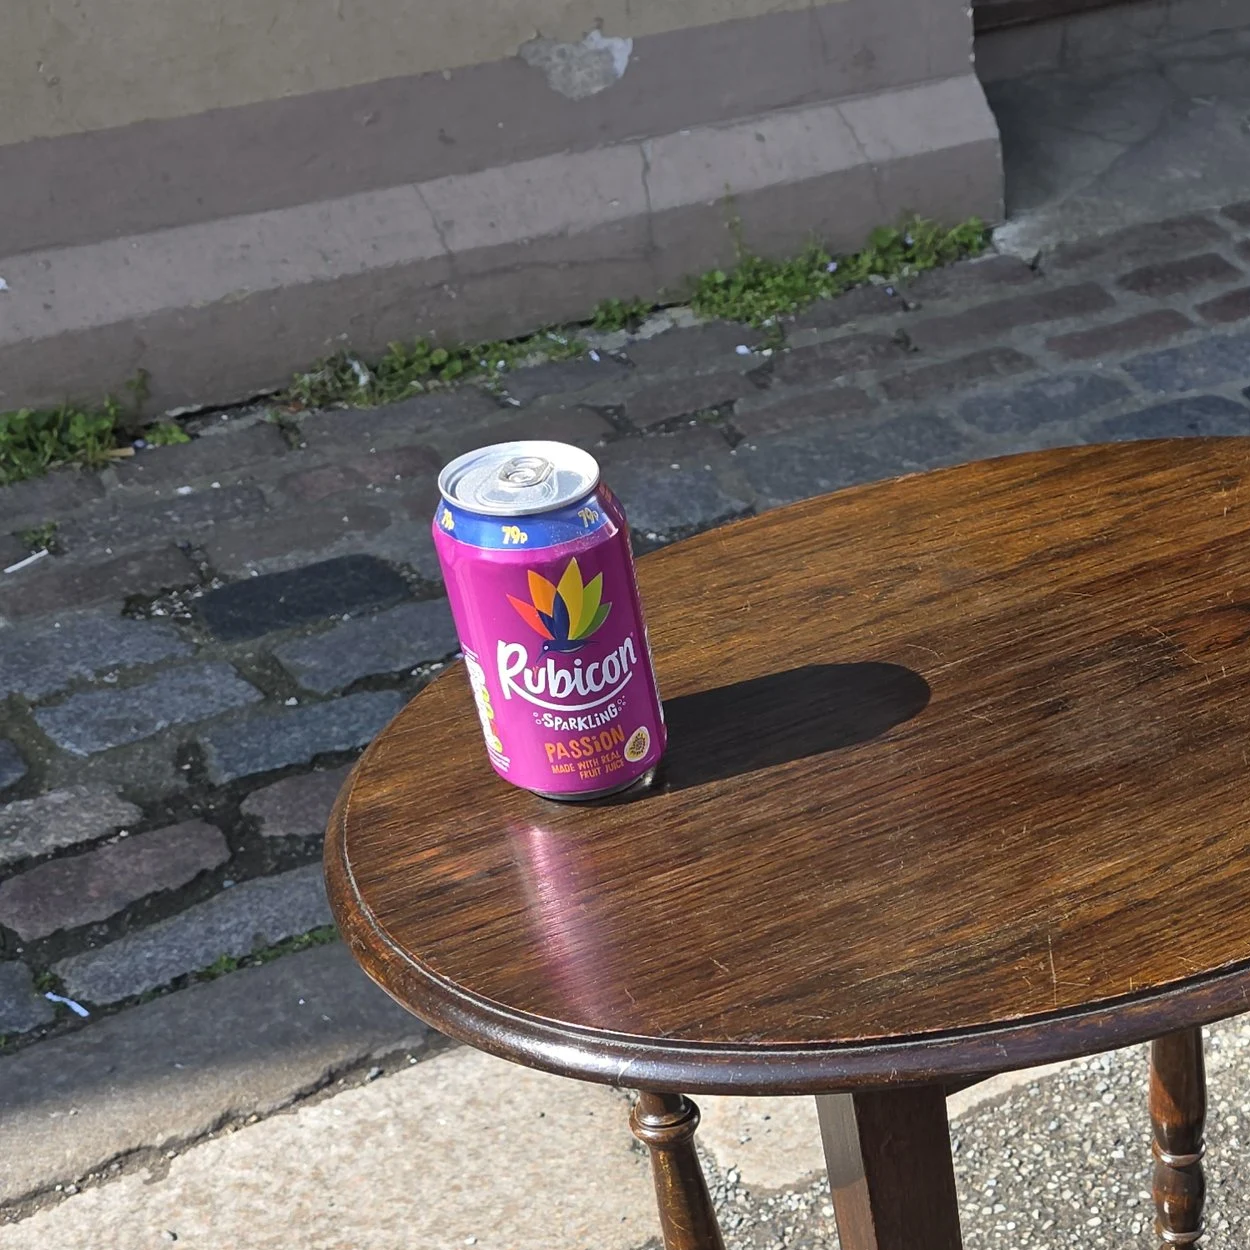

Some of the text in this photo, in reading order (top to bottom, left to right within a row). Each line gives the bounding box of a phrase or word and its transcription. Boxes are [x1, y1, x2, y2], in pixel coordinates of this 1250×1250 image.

[577, 507, 599, 528] 79p
[501, 525, 528, 545] 79p
[497, 636, 637, 700] Rubicon
[551, 750, 621, 774] MADE WITH REAL
[579, 758, 625, 780] FRUIT JUICE
